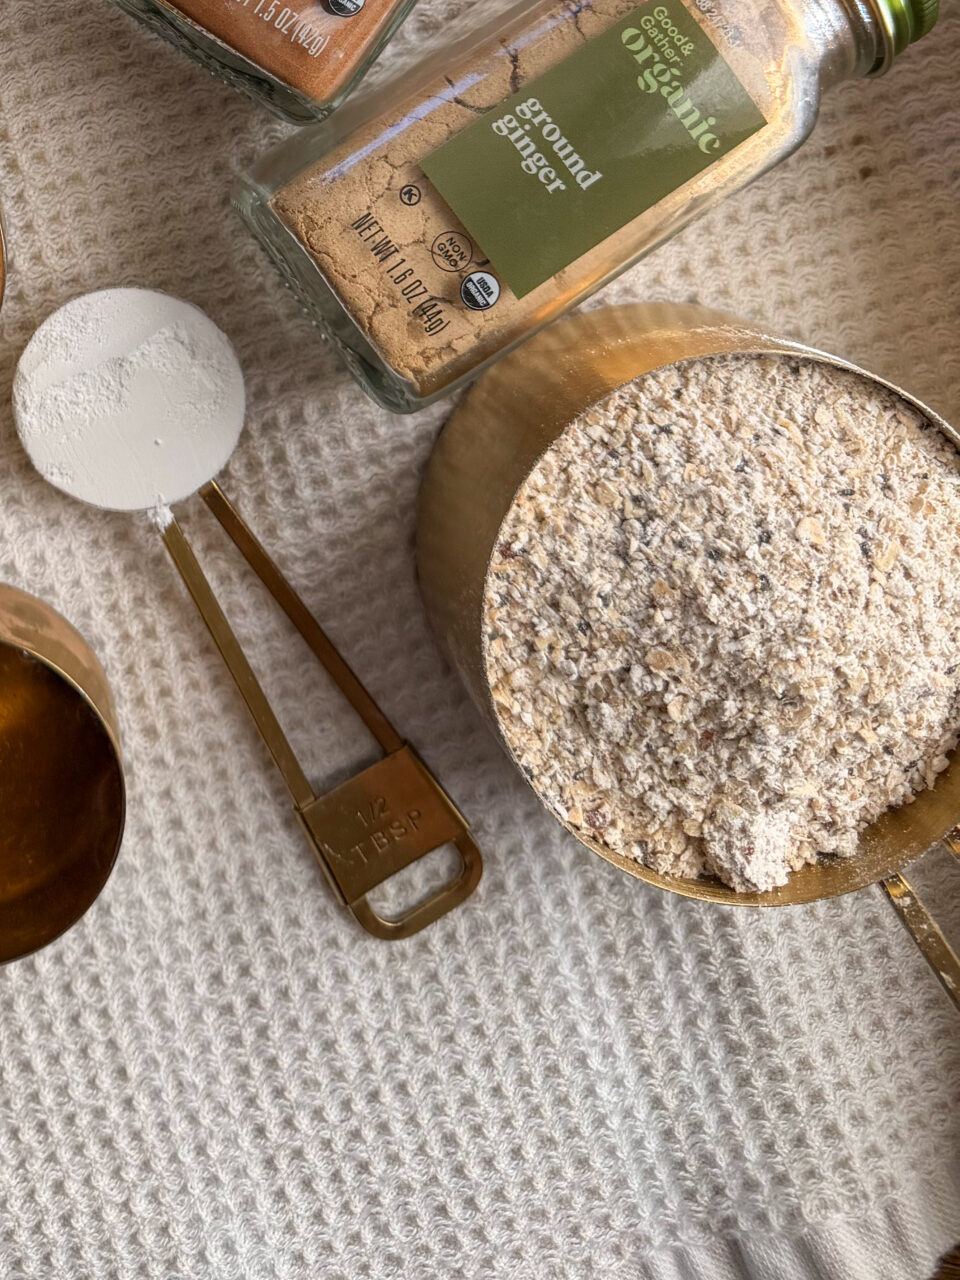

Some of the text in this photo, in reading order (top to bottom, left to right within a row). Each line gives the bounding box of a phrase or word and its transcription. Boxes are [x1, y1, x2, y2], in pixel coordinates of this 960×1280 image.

[273, 7, 299, 35] OZ
[290, 21, 330, 58] (42g)
[621, 27, 720, 154] organic
[491, 114, 566, 194] ginger
[515, 98, 603, 191] ground
[351, 212, 451, 337] NET WT 1.6 OZ (44g)
[437, 242, 458, 268] GMO
[446, 237, 467, 262] NON
[466, 281, 486, 306] ORGANIC
[476, 276, 494, 298] USDA
[351, 808, 422, 864] TBSP
[357, 796, 390, 828] 1/2
